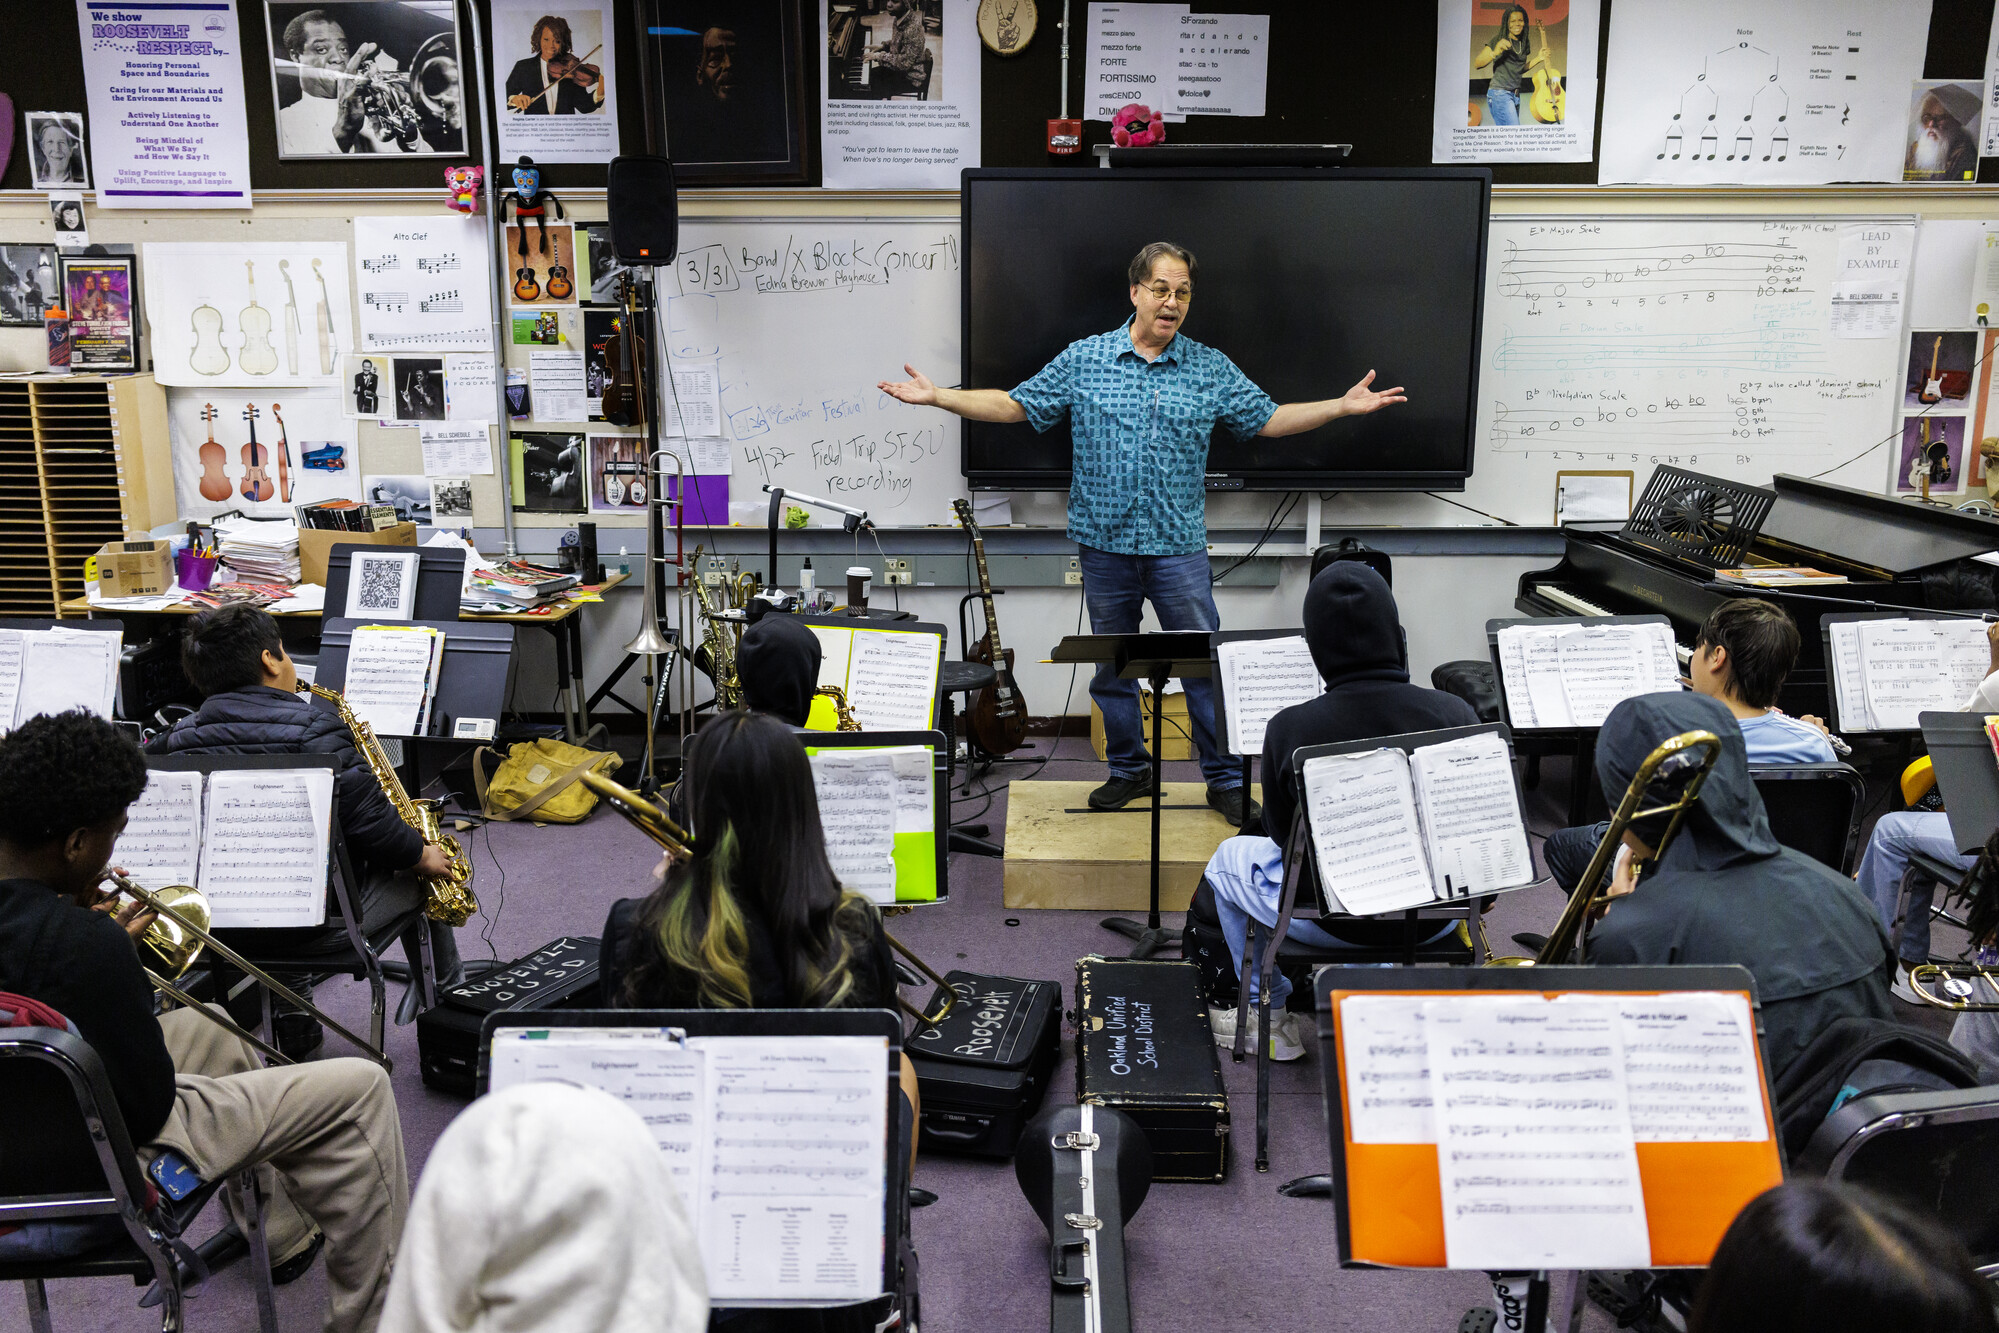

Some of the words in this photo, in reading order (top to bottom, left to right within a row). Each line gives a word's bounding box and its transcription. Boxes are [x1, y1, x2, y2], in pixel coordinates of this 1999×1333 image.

[91, 12, 110, 22] We
[112, 11, 142, 22] show
[1181, 17, 1218, 25] SForzando
[92, 24, 190, 38] ROOSEVELT
[137, 41, 212, 55] RESPECT
[1101, 58, 1127, 66] FORTE
[120, 70, 144, 78] Space
[164, 70, 210, 78] Boundaries
[1100, 74, 1156, 83] FORTISSIMO
[110, 86, 136, 95] Caring
[138, 86, 150, 94] for
[1099, 90, 1141, 100] cresCENDO
[128, 112, 160, 120] Actively
[162, 112, 200, 120] Listening
[186, 154, 201, 162] Say
[118, 169, 141, 177] Using
[177, 170, 216, 178] Language
[114, 177, 139, 185] Uplift,
[204, 178, 232, 186] Inspire
[1550, 226, 1574, 236] Major
[1579, 224, 1600, 234] Scale
[1862, 232, 1891, 241] LEAD
[813, 240, 872, 271] Block
[1867, 246, 1882, 255] BY
[1847, 260, 1900, 269] EXAMPLE
[756, 275, 787, 292] Edna
[1600, 390, 1628, 400] Scale
[776, 400, 813, 424] Guitar
[822, 396, 866, 422] Festival
[744, 445, 795, 484] 4/22
[812, 440, 842, 470] Field
[846, 434, 876, 463] Trip
[883, 425, 944, 464] SFSU
[826, 460, 912, 508] recording
[370, 506, 394, 514] ESSENTIAL
[453, 938, 576, 998] ROOSEVELT
[1104, 996, 1127, 1030] Unified
[1131, 1002, 1154, 1034] District
[953, 991, 1014, 1056] Roosevelt
[1109, 1035, 1131, 1075] Oakland
[1136, 1037, 1158, 1069] School
[591, 1061, 639, 1071] Enlightenment
